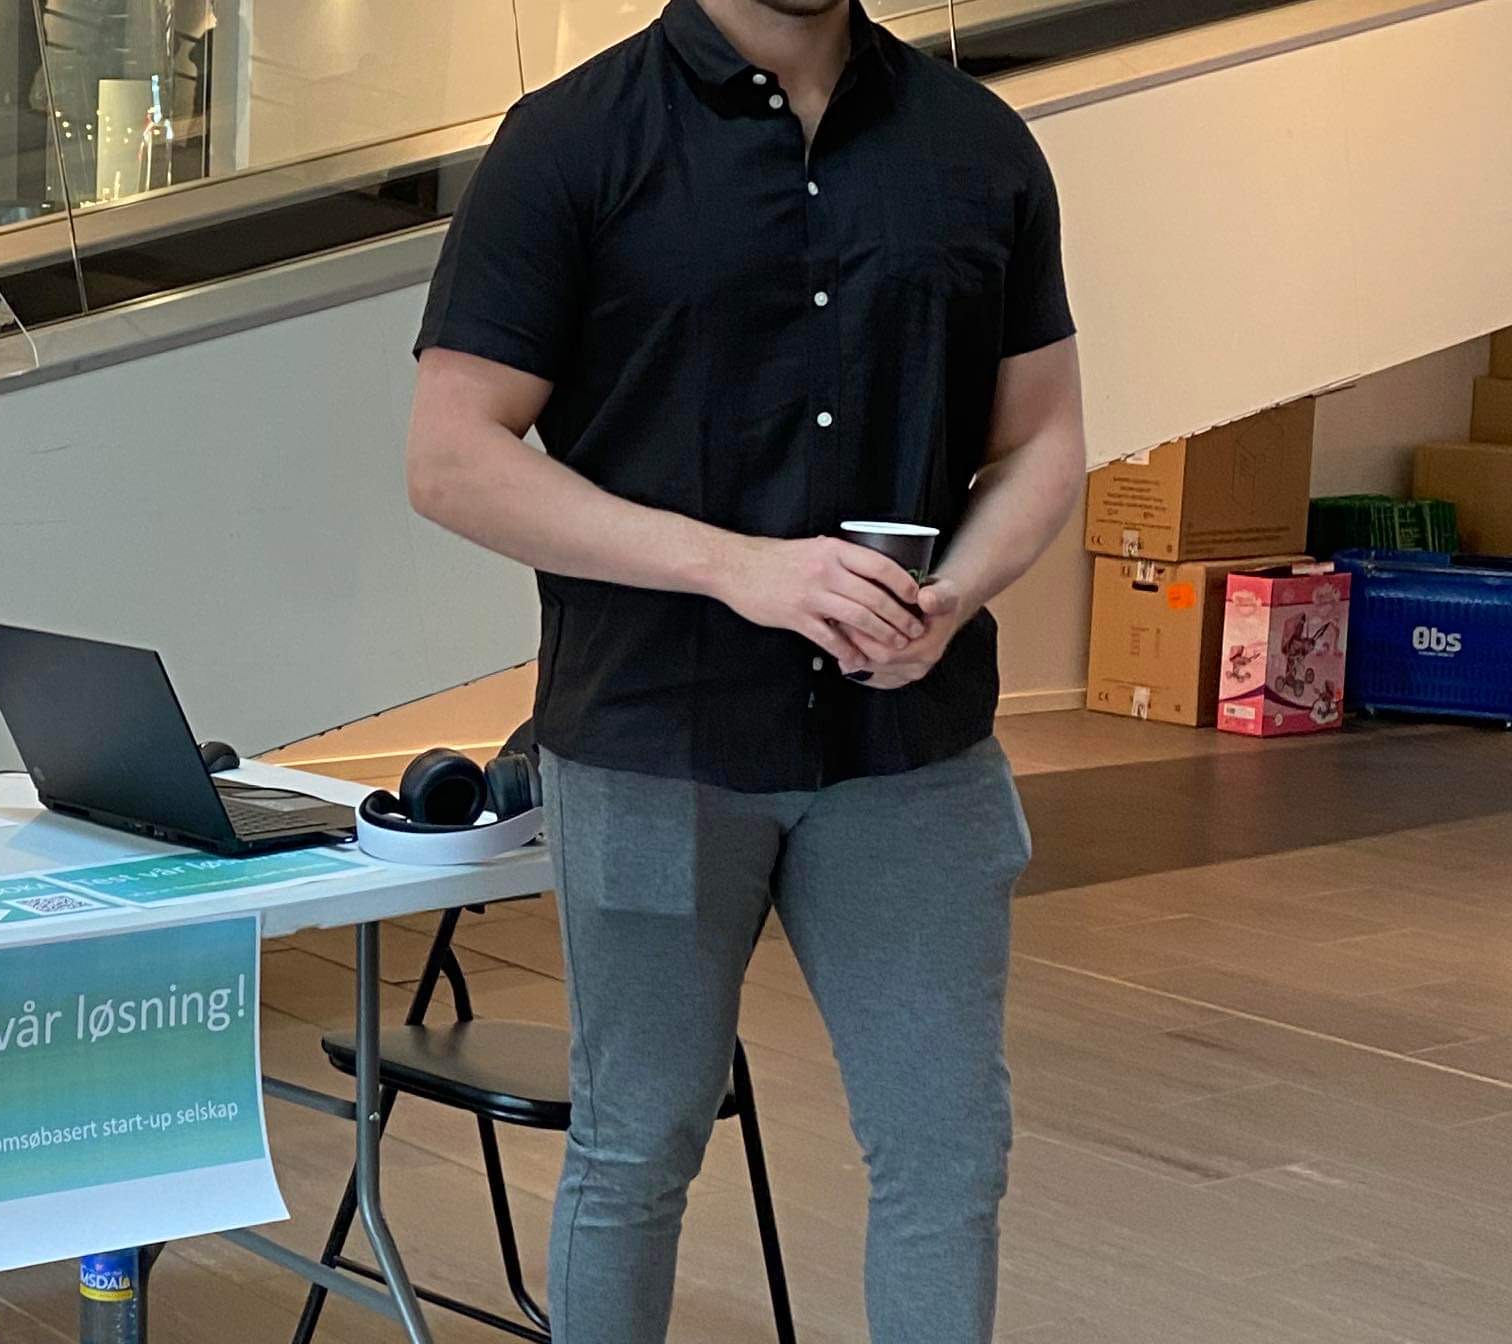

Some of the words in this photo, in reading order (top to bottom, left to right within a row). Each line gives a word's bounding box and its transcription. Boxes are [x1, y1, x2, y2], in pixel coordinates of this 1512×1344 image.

[76, 974, 246, 1042] løsning!
[102, 1110, 173, 1137] start-up
[176, 1099, 239, 1126] selskap
[81, 1270, 129, 1290] MSDAL
